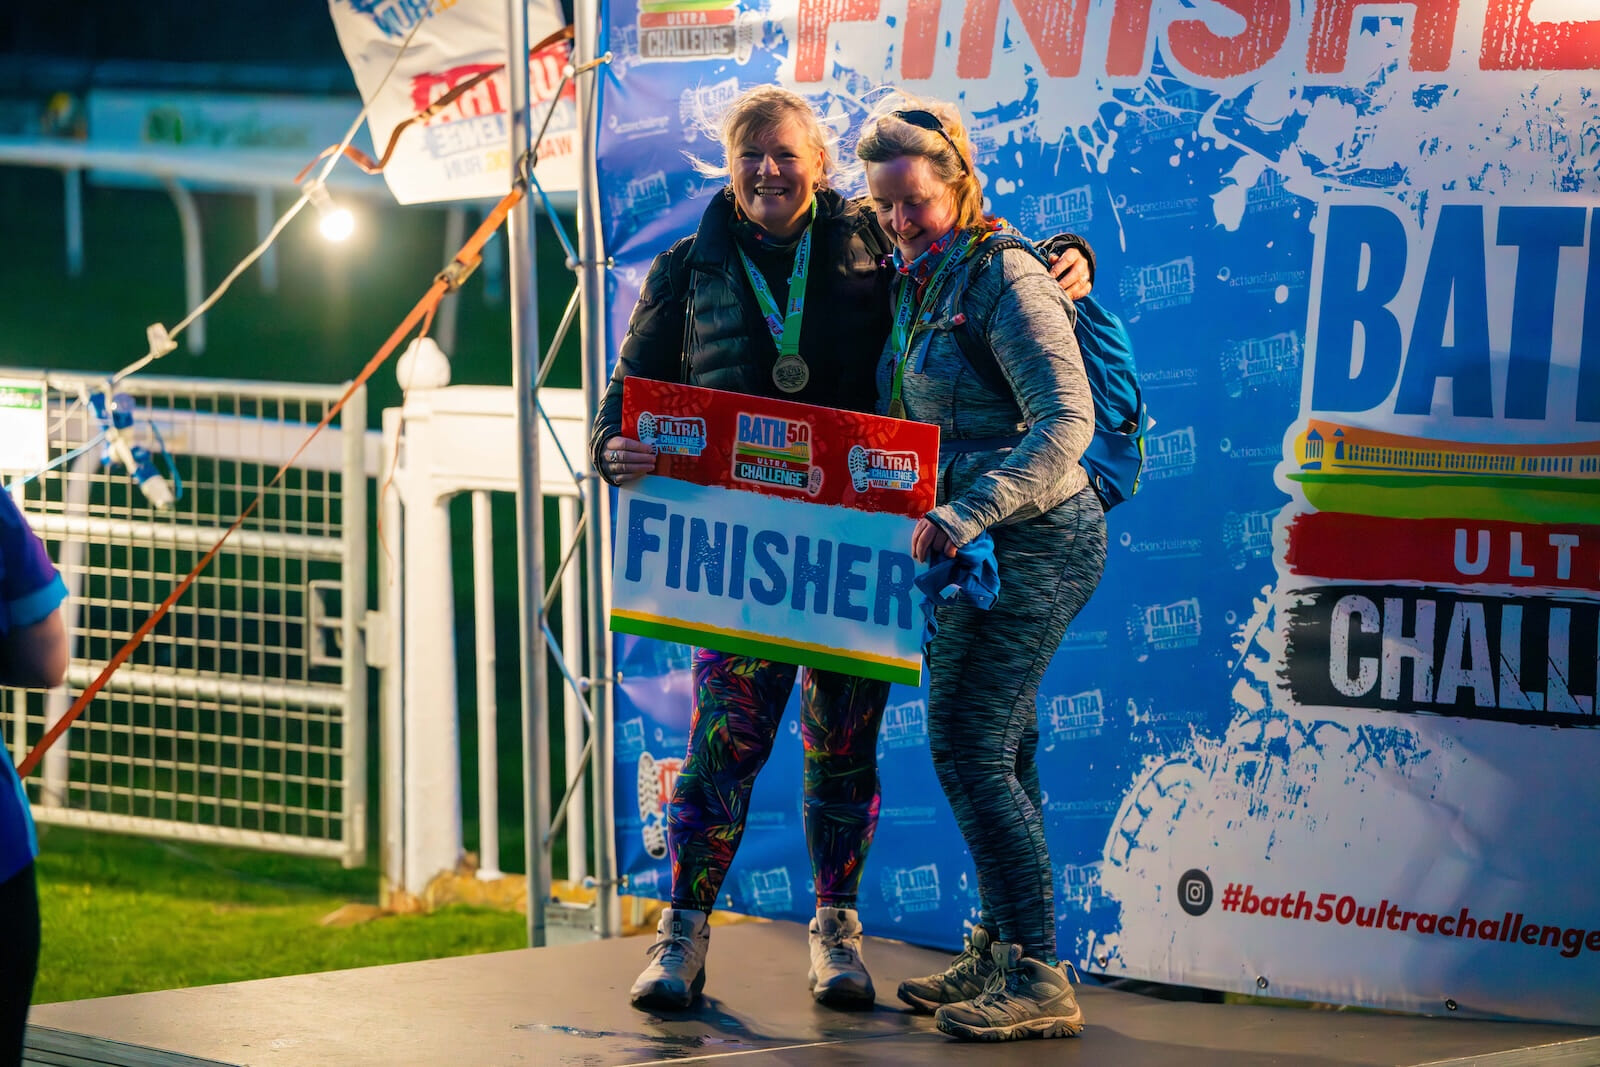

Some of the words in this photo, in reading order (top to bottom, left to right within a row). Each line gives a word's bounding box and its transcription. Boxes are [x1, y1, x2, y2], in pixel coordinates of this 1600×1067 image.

[667, 12, 707, 25] ULTRA
[648, 29, 730, 56] CHALLENGE
[1044, 192, 1088, 216] ULTRA
[1143, 263, 1189, 287] ULTRA
[1312, 204, 1600, 423] BAT
[1246, 338, 1294, 362] ULTRA
[660, 420, 699, 437] ULTRA
[1146, 433, 1191, 457] ULTRA
[757, 457, 788, 469] ULTRA
[871, 469, 912, 481] CHALLENGE
[872, 455, 912, 472] ULTRA
[741, 464, 803, 487] CHALLENGE
[625, 499, 916, 630] FINISHER
[1454, 528, 1600, 580] ULT
[1150, 605, 1195, 627] ULTRA
[1329, 594, 1600, 715] CHALL
[1055, 696, 1100, 718] ULTRA
[1221, 882, 1600, 958] #bath50ultrachallenge
